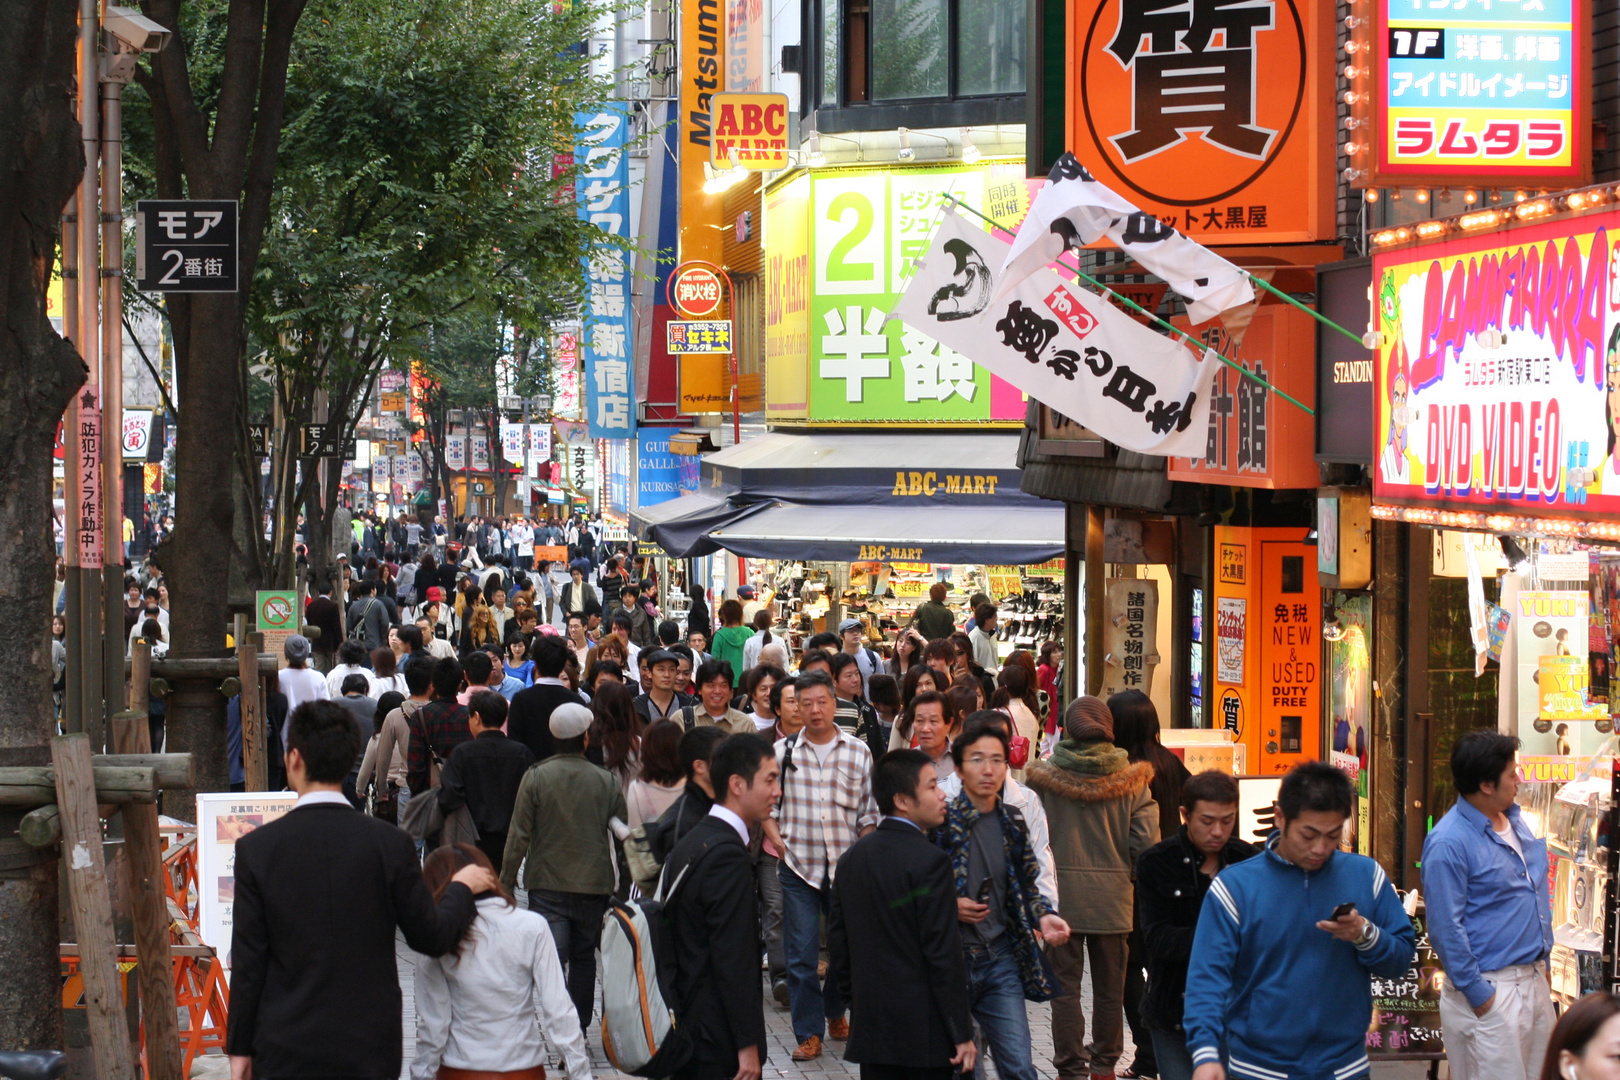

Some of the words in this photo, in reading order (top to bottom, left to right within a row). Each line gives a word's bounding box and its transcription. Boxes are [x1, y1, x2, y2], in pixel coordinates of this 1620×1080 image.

[1393, 31, 1440, 55] 1F
[1103, 0, 1279, 165] 質
[1392, 72, 1569, 99] アイドルイメージ
[716, 104, 785, 136] ABC
[1394, 118, 1566, 159] ラムタラ
[716, 139, 785, 160] MART
[901, 190, 967, 211] ビジネス
[988, 182, 1017, 202] 同時
[991, 199, 1020, 219] 開催
[1148, 205, 1268, 233] ット大黒屋
[158, 210, 223, 239] モア
[826, 192, 874, 282] 2
[160, 250, 223, 284] 2番街
[679, 282, 717, 301] 消火栓
[767, 253, 808, 327] ABC-MART
[670, 325, 686, 344] 質
[687, 330, 729, 344] セキネ
[820, 304, 977, 403] 半額
[559, 332, 578, 407] カラオケ
[574, 446, 587, 490] カラオケ
[81, 422, 97, 548] 防犯カメラ作動中
[892, 471, 998, 496] ABC-MART
[858, 545, 923, 560] ABC-MART
[1222, 549, 1243, 562] チケット
[1222, 563, 1244, 580] 大黒屋
[1274, 603, 1308, 623] 免税
[1519, 597, 1577, 618] YUKI
[1122, 591, 1145, 691] 諸国名物創作
[1273, 626, 1312, 646] NEW
[1289, 647, 1298, 662] &
[1272, 662, 1316, 683] USED
[1272, 686, 1309, 696] DUTY
[1273, 697, 1307, 707] FREE
[1221, 695, 1241, 736] 質
[1520, 763, 1576, 781] YUKI
